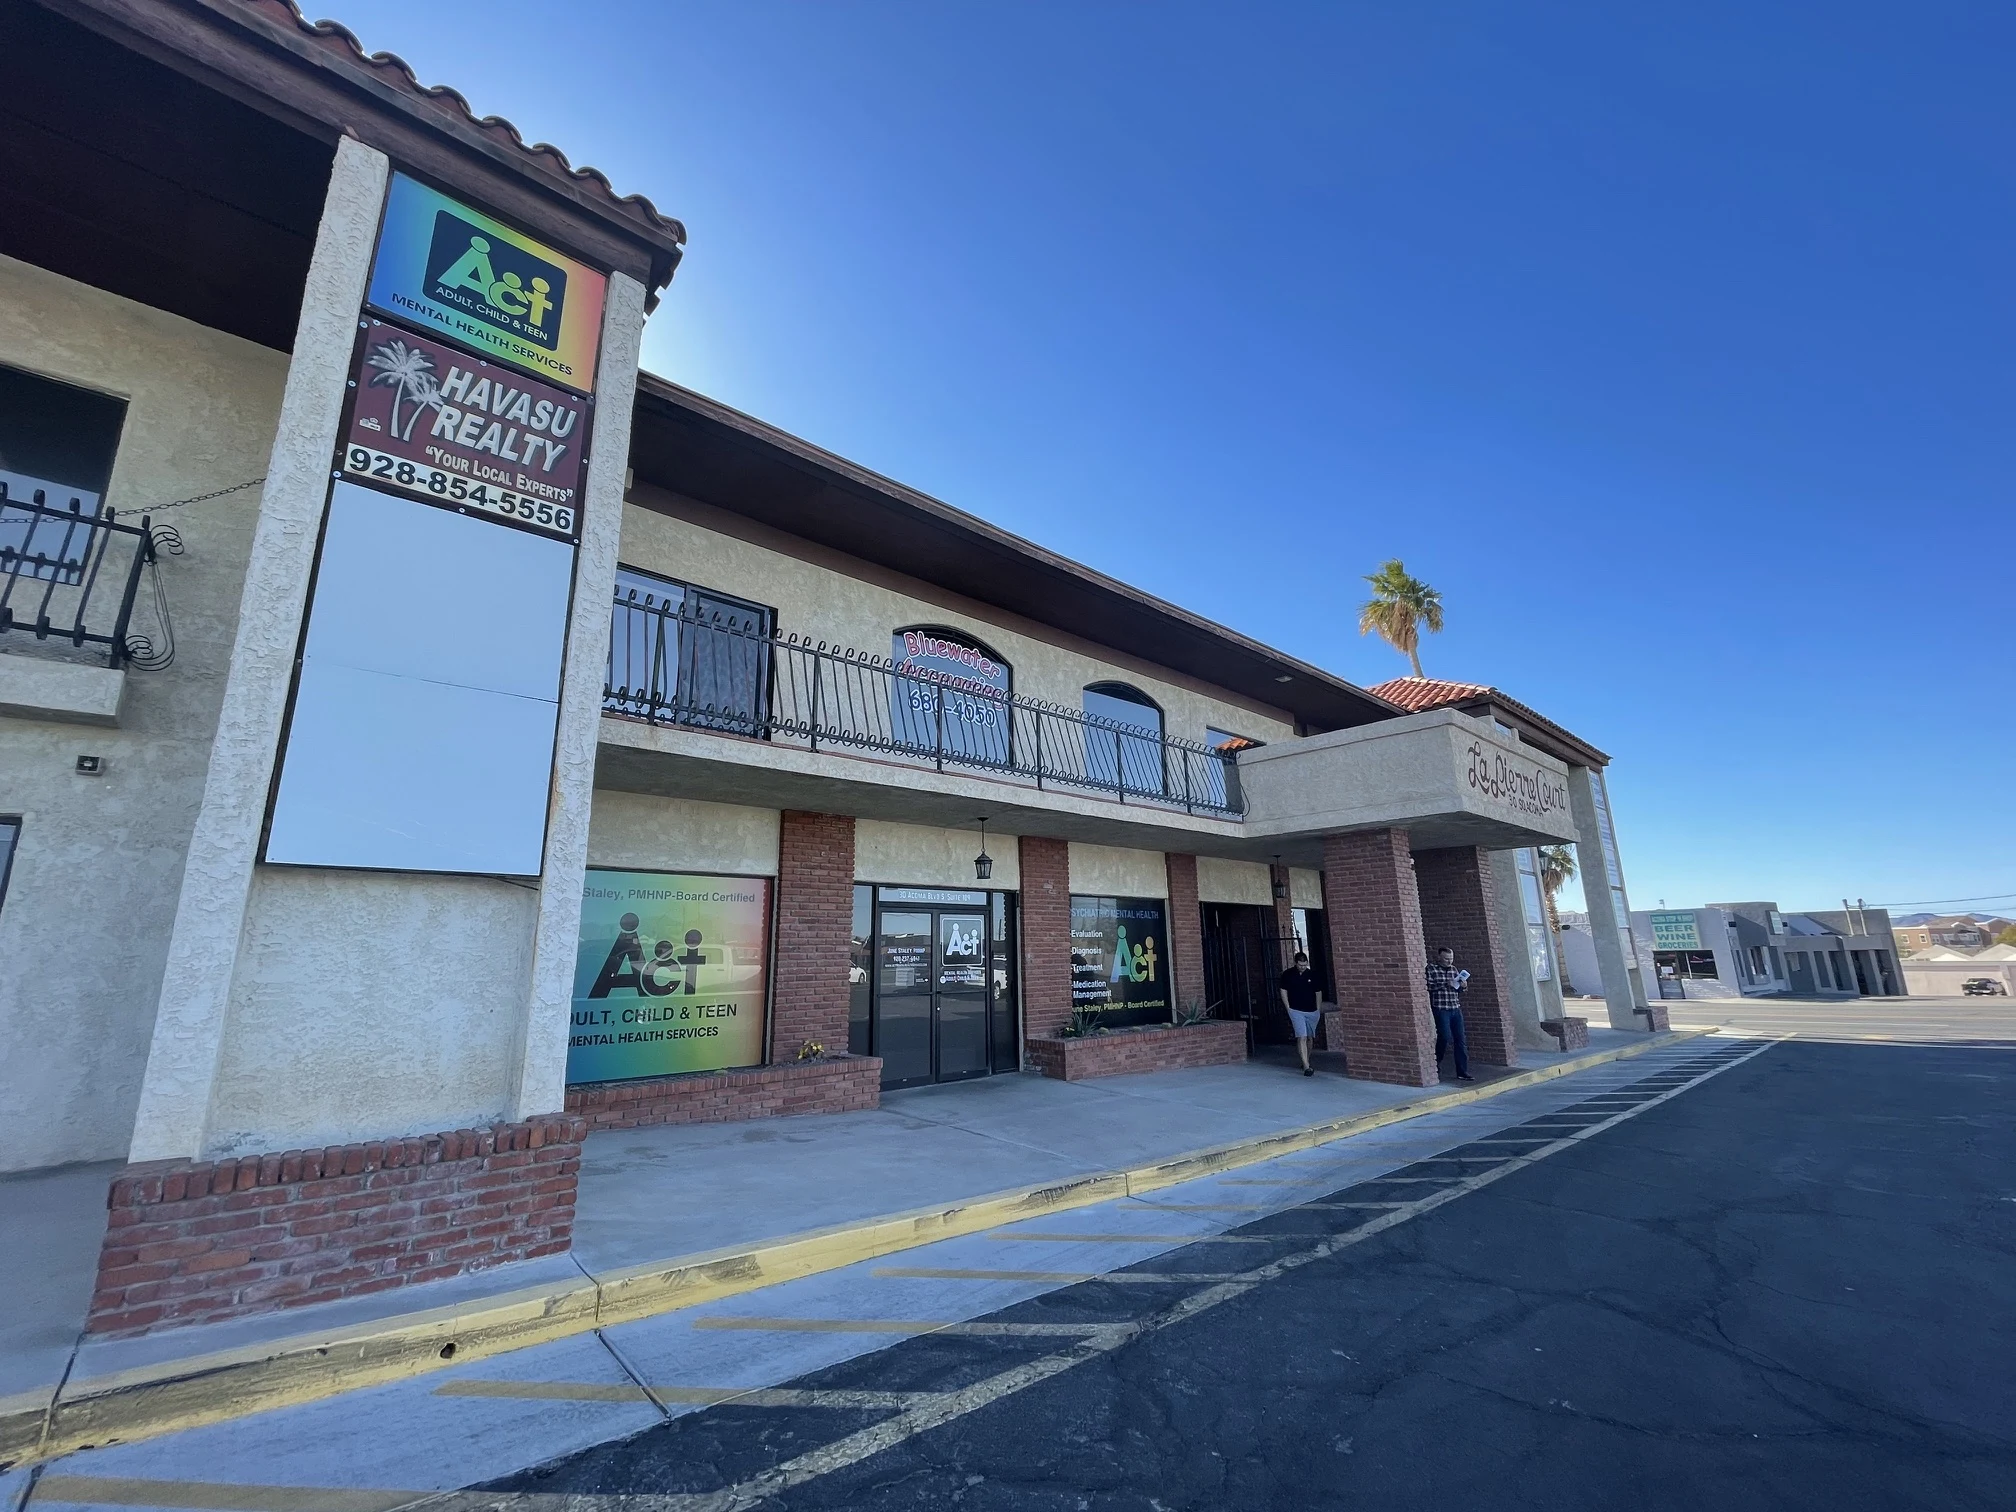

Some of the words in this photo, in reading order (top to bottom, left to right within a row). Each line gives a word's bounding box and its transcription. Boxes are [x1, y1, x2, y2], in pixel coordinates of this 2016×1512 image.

[437, 236, 553, 327] Act
[435, 286, 473, 310] ADULT,
[476, 304, 510, 324] CHILD
[512, 319, 522, 329] &
[523, 323, 548, 341] TEEN
[391, 292, 452, 326] MENTAL
[455, 320, 510, 350] HEALTH
[511, 344, 573, 376] SERVICES
[439, 365, 578, 438] HAVASU
[430, 404, 567, 473] REALTY
[349, 448, 572, 530] 928-854-5556
[472, 460, 513, 486] LOCAL
[904, 631, 1001, 679] Bluewater
[1467, 741, 1491, 795] La
[1490, 751, 1537, 801] Pierre
[1536, 769, 1566, 812] Court
[582, 887, 625, 901] Staley,
[628, 889, 708, 902] PMHNP-Board
[711, 892, 756, 904] Certified
[1070, 908, 1109, 919] SYCHIATRIC
[1110, 909, 1135, 919] MENTAL
[1136, 910, 1159, 919] HEALTH
[1654, 924, 1694, 933] BEER
[946, 922, 980, 956] Act
[1656, 932, 1697, 941] WINE
[1657, 941, 1699, 949] GROCERIES
[587, 912, 706, 999] Act
[1110, 925, 1158, 983] Act
[1072, 1005, 1084, 1014] une
[1127, 1001, 1144, 1009] Board
[1144, 999, 1165, 1008] Certified
[1073, 989, 1112, 1000] Management
[570, 1009, 616, 1027] ULT,
[621, 1006, 675, 1024] CHILD
[679, 1006, 691, 1020] &
[696, 1003, 738, 1019] TEEN
[568, 1034, 615, 1048] MENTAL
[618, 1030, 664, 1044] HEALTH
[665, 1026, 719, 1041] SERVICES
